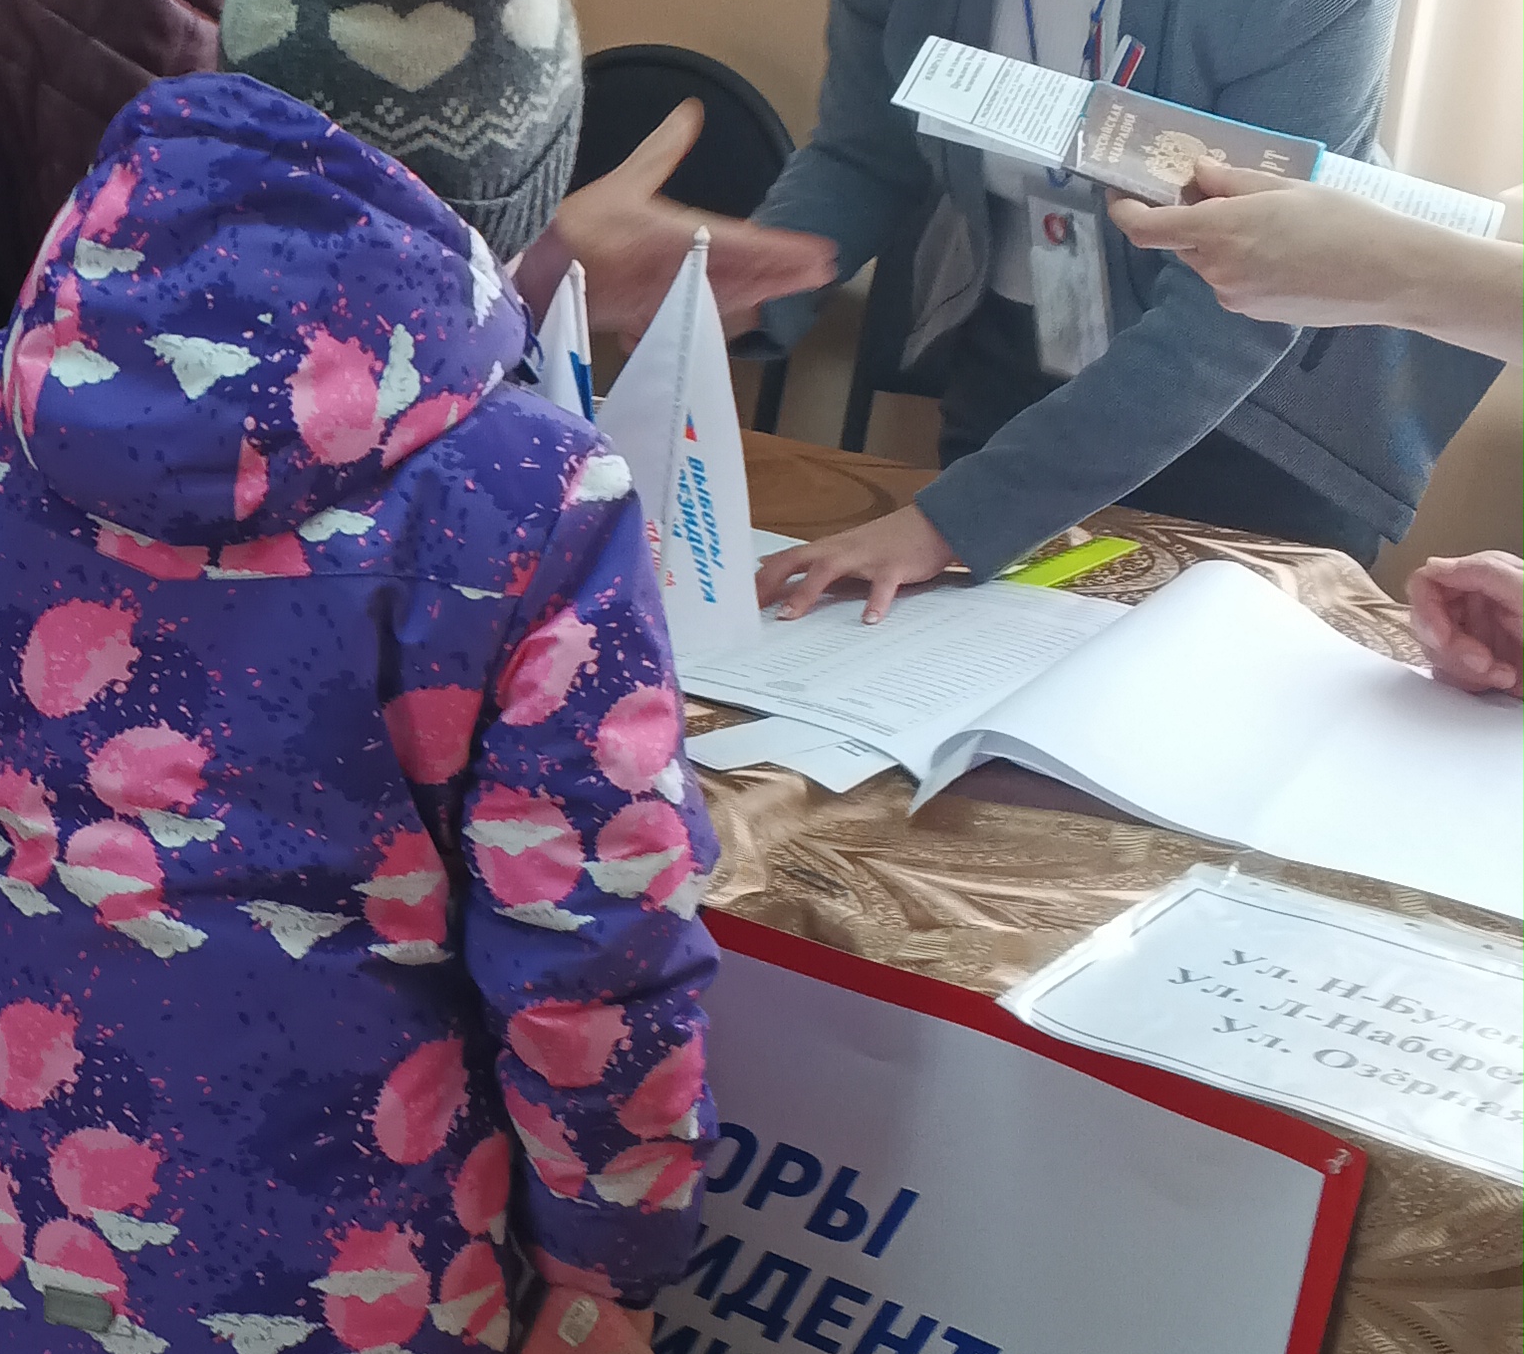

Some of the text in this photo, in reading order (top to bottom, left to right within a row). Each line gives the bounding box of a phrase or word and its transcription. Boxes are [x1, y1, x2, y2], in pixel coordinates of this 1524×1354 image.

[686, 455, 725, 570] ВЫБОРЫ
[1167, 967, 1245, 1003] Ул.
[1221, 948, 1299, 984] Ул.
[1211, 1015, 1293, 1054] Ул.
[704, 1121, 921, 1259] ОРЫ
